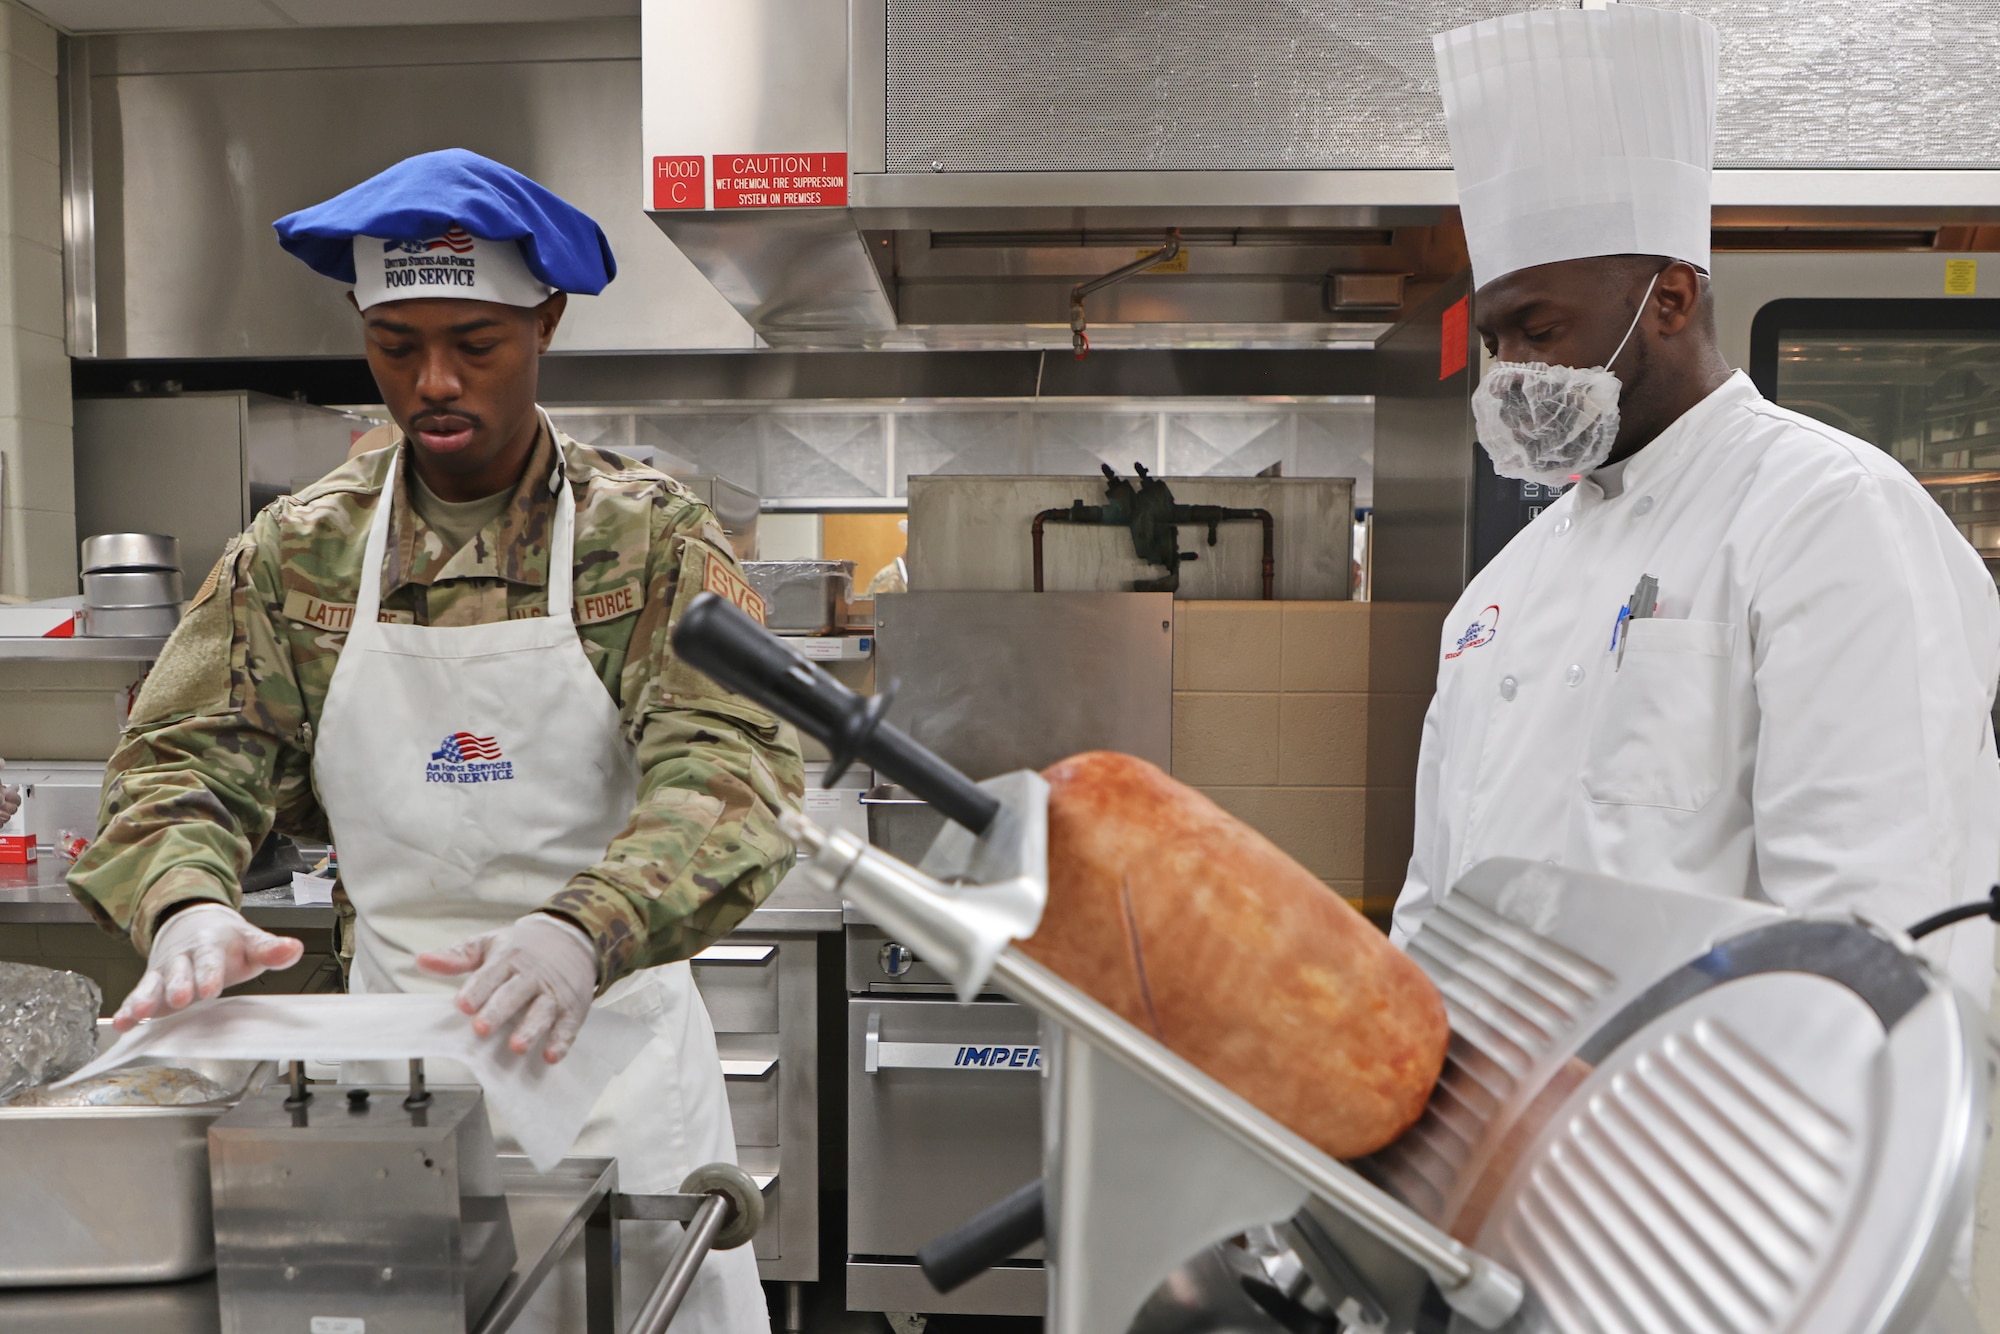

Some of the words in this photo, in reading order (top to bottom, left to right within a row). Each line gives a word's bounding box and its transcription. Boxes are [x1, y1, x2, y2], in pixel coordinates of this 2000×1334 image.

[658, 160, 700, 178] HOOD
[732, 156, 811, 174] CAUTION
[715, 178, 731, 190] WET
[733, 176, 770, 190] CHEMICAL
[773, 176, 790, 189] FIRE
[793, 176, 844, 188] SUPPRESSION
[671, 181, 687, 204] C
[738, 193, 767, 205] SYSTEM
[769, 193, 781, 204] ON
[783, 192, 822, 204] PREMISES
[385, 269, 416, 288] FOOD
[418, 268, 474, 287] SERVICE
[583, 587, 634, 620] FORCE
[712, 565, 762, 624] SVS
[426, 771, 456, 783] FOOD
[458, 769, 514, 783] SERVICE
